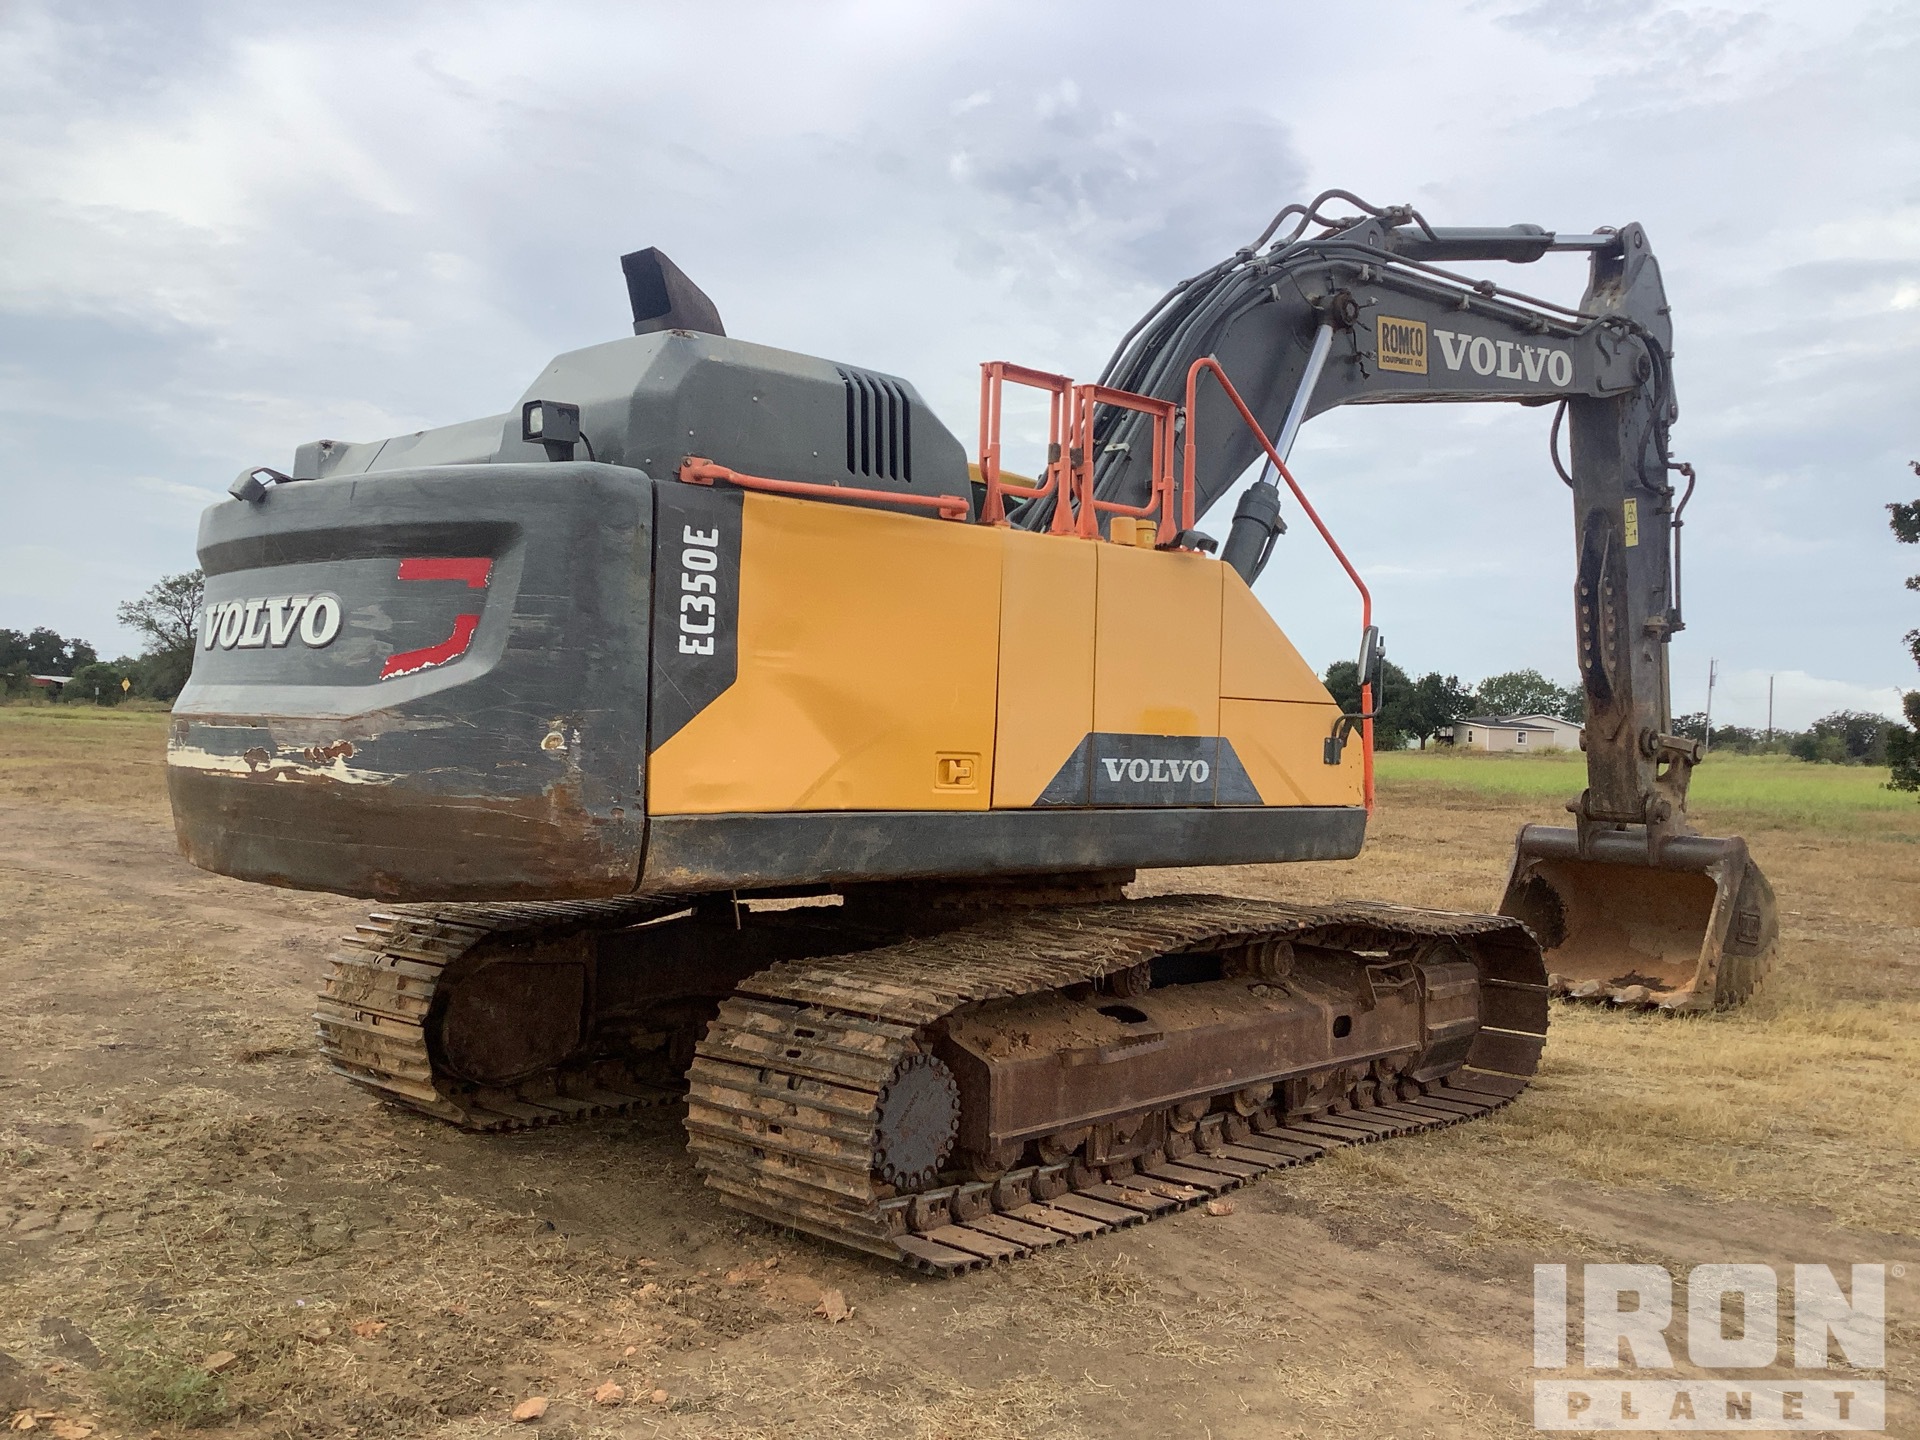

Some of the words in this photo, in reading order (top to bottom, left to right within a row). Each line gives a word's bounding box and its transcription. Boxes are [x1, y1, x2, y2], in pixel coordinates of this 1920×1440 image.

[1382, 322, 1424, 357] ROMCO
[1382, 355, 1414, 366] EQUIPMENT
[1433, 329, 1573, 387] VOLVO
[679, 525, 719, 656] EC350E
[203, 592, 342, 649] VOLVO
[1102, 758, 1210, 783] VOLVO
